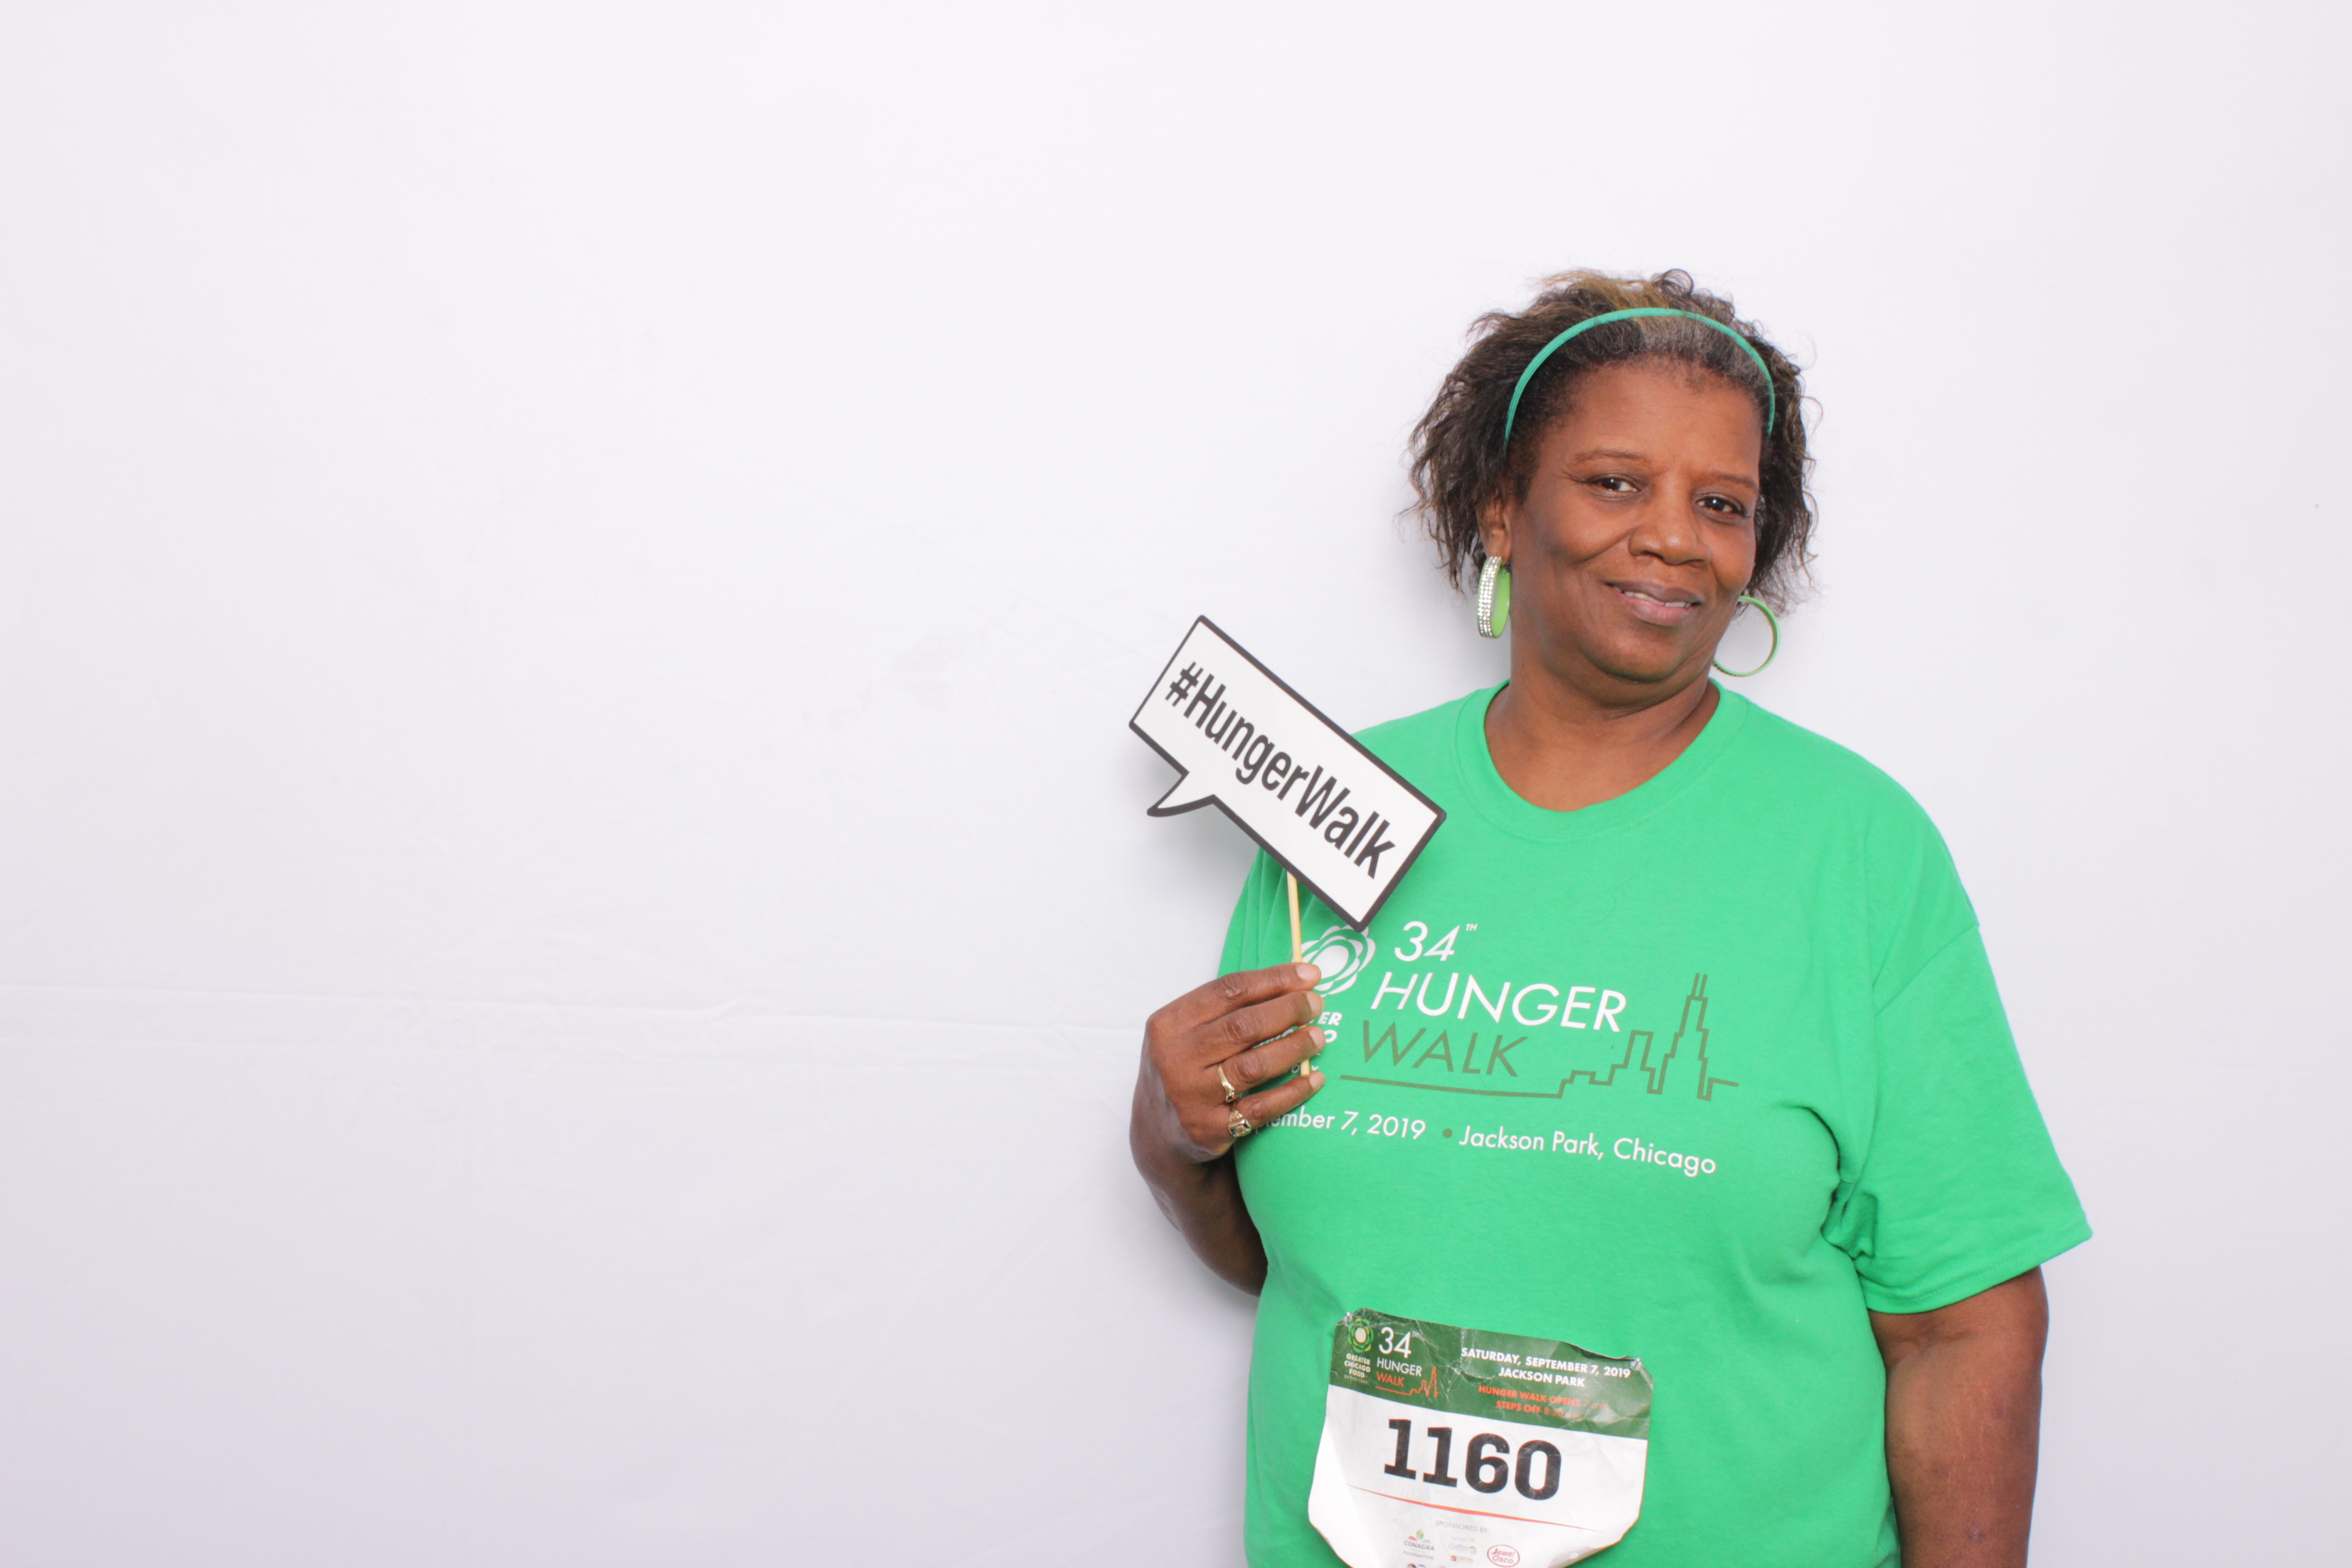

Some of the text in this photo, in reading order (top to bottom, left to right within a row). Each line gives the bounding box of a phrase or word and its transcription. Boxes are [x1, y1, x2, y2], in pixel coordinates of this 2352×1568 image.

[1165, 662, 1396, 879] #HungerWalk
[1371, 971, 1627, 1032] HUNGER
[1363, 1020, 1529, 1077] WALK
[1341, 1111, 1359, 1135] 7,
[1367, 1114, 1426, 1140] 2019
[1458, 1126, 1716, 1177] Jackson Park, Chicago
[1344, 1360, 1371, 1373] CHICAGO
[1346, 1353, 1371, 1365] GREATER
[1377, 1357, 1422, 1377] HUNGER
[1461, 1348, 1631, 1379] SATURDAY, SEPTEMBER 7, 2019
[1349, 1368, 1365, 1379] FOOD
[1376, 1371, 1405, 1387] WALK
[1499, 1367, 1585, 1388] JACKSON PARK
[1478, 1386, 1518, 1399] HUNGER
[1519, 1392, 1547, 1403] WALK
[1549, 1396, 1581, 1407] OPENS
[1496, 1401, 1522, 1412] STEPS
[1524, 1405, 1541, 1414] OFF
[1384, 1419, 1562, 1501] 1160
[1435, 1520, 1477, 1532] SPONSORED
[1403, 1540, 1435, 1551] CONAGRA
[1403, 1550, 1434, 1561] FOUNDATION
